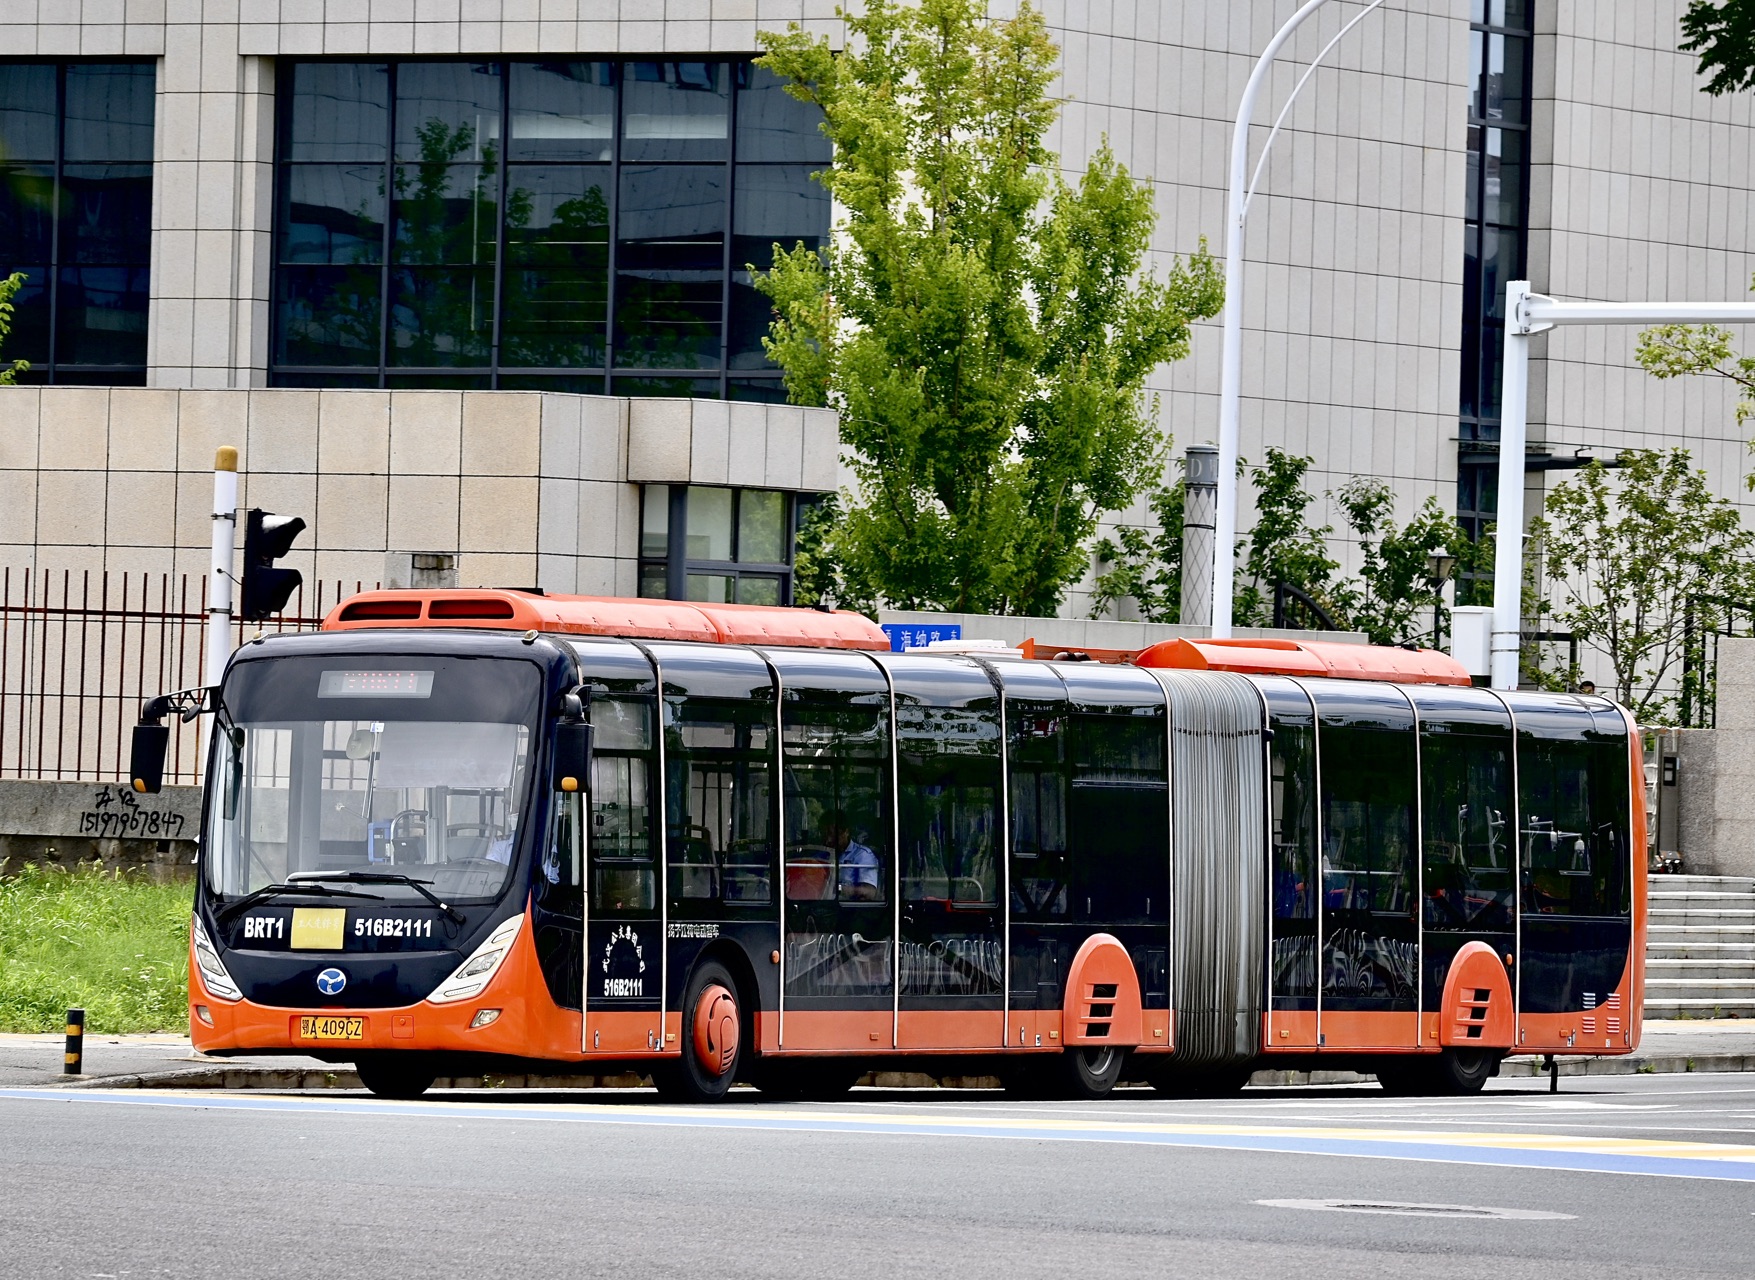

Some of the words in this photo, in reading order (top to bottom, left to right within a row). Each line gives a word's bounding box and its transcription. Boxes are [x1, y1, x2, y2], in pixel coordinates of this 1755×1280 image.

[79, 809, 185, 838] 15197967847
[244, 917, 284, 939] BRT1
[355, 918, 432, 938] 516B2111
[667, 923, 720, 938] 扬子江纯电动客车
[604, 978, 643, 997] 516B2111
